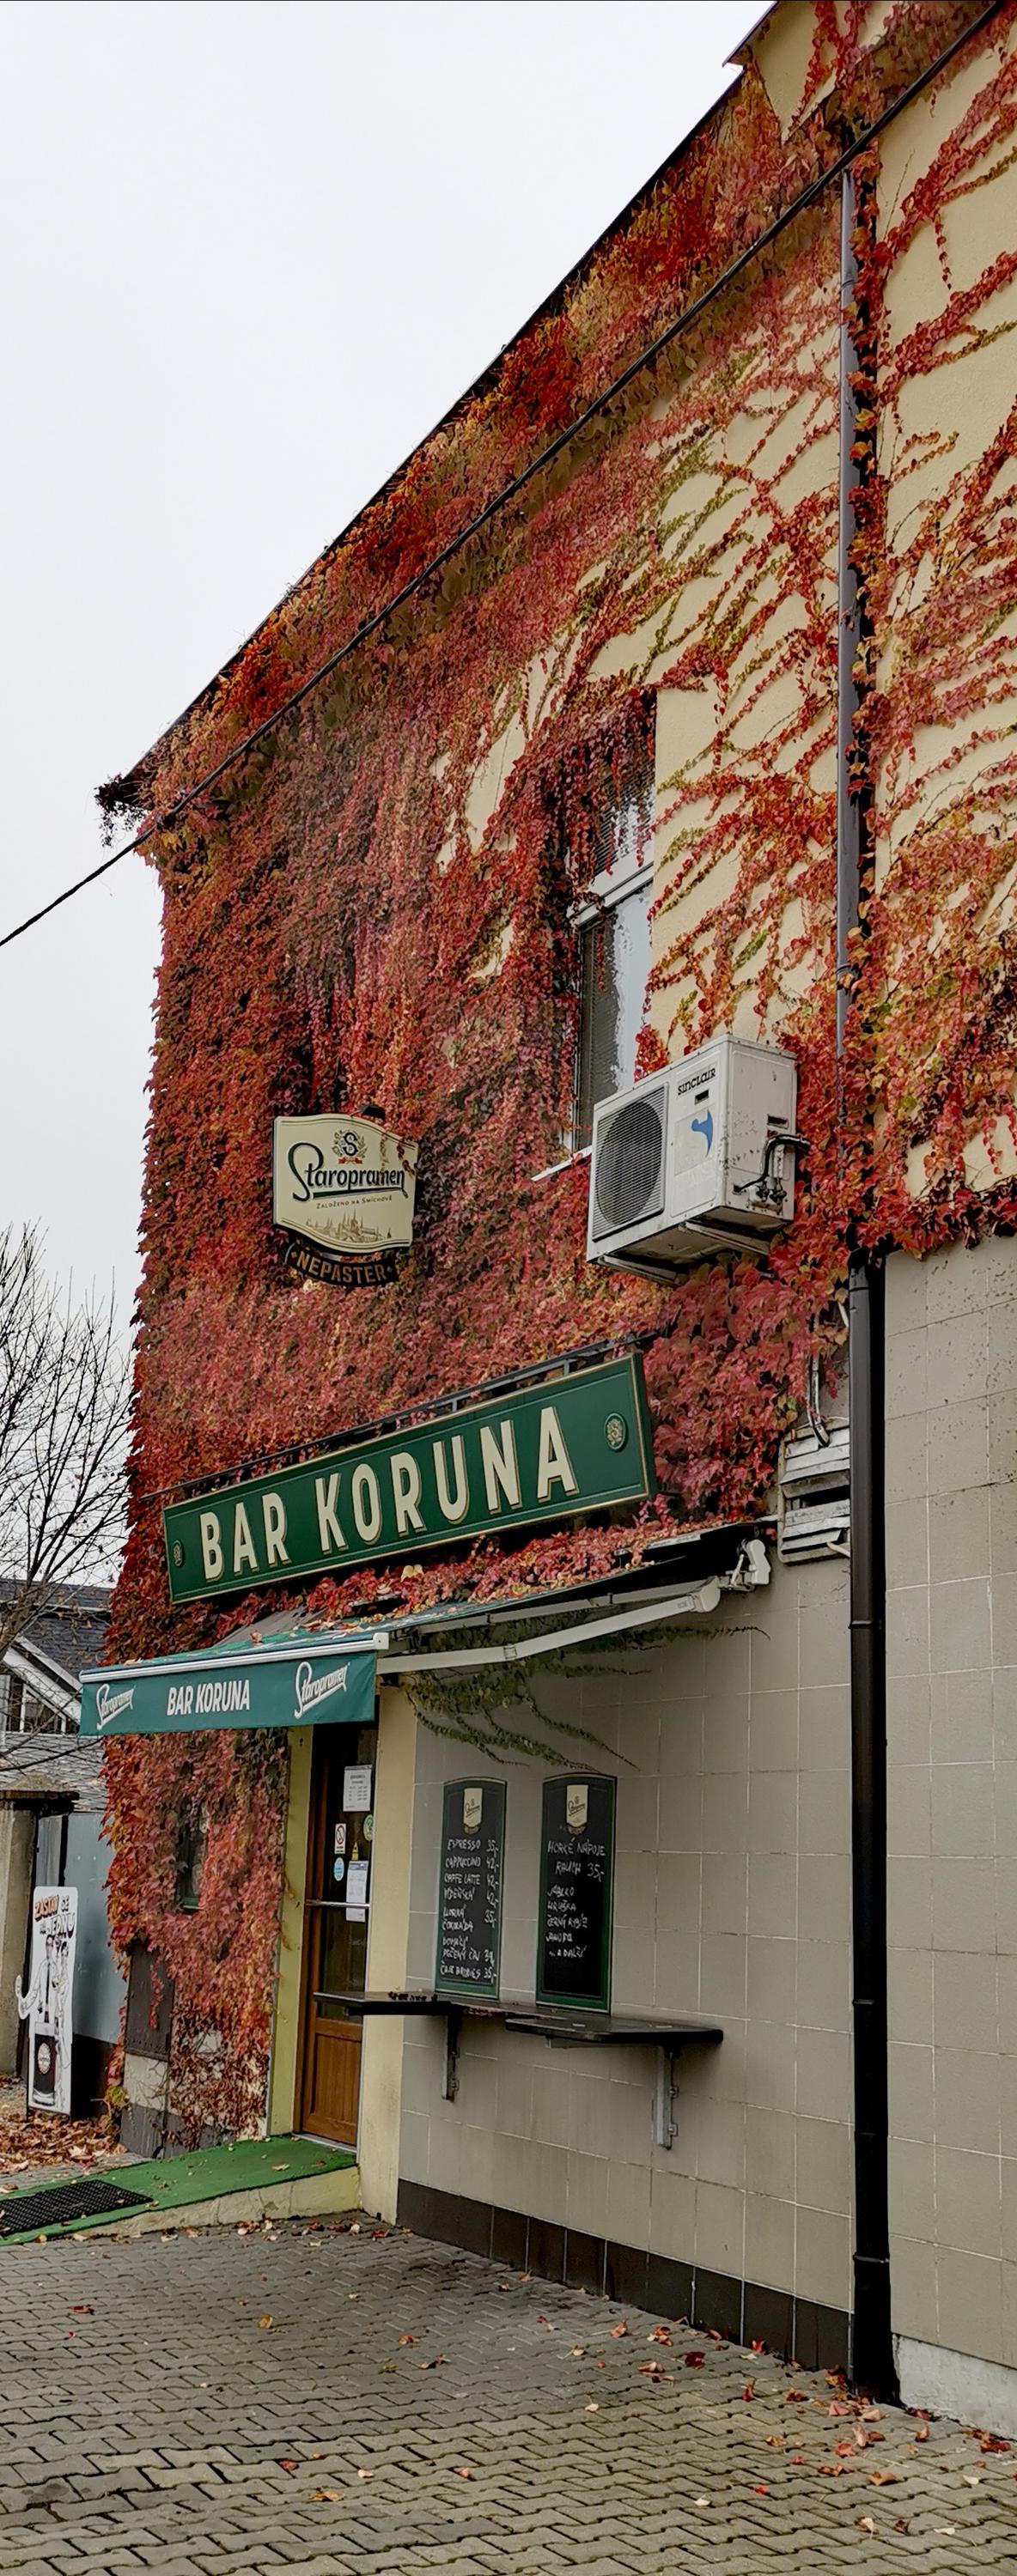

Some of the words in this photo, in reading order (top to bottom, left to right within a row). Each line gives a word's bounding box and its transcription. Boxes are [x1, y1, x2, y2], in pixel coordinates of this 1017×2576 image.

[288, 1142, 408, 1201] Staropramen
[297, 1250, 387, 1284] NEPASTER
[199, 1492, 293, 1582] BAR
[315, 1406, 580, 1553] KORUNA
[96, 1683, 137, 1730] Staropramen
[167, 1685, 194, 1716] BAR
[195, 1679, 250, 1713] KORUNA
[294, 1661, 351, 1719] Staropramen
